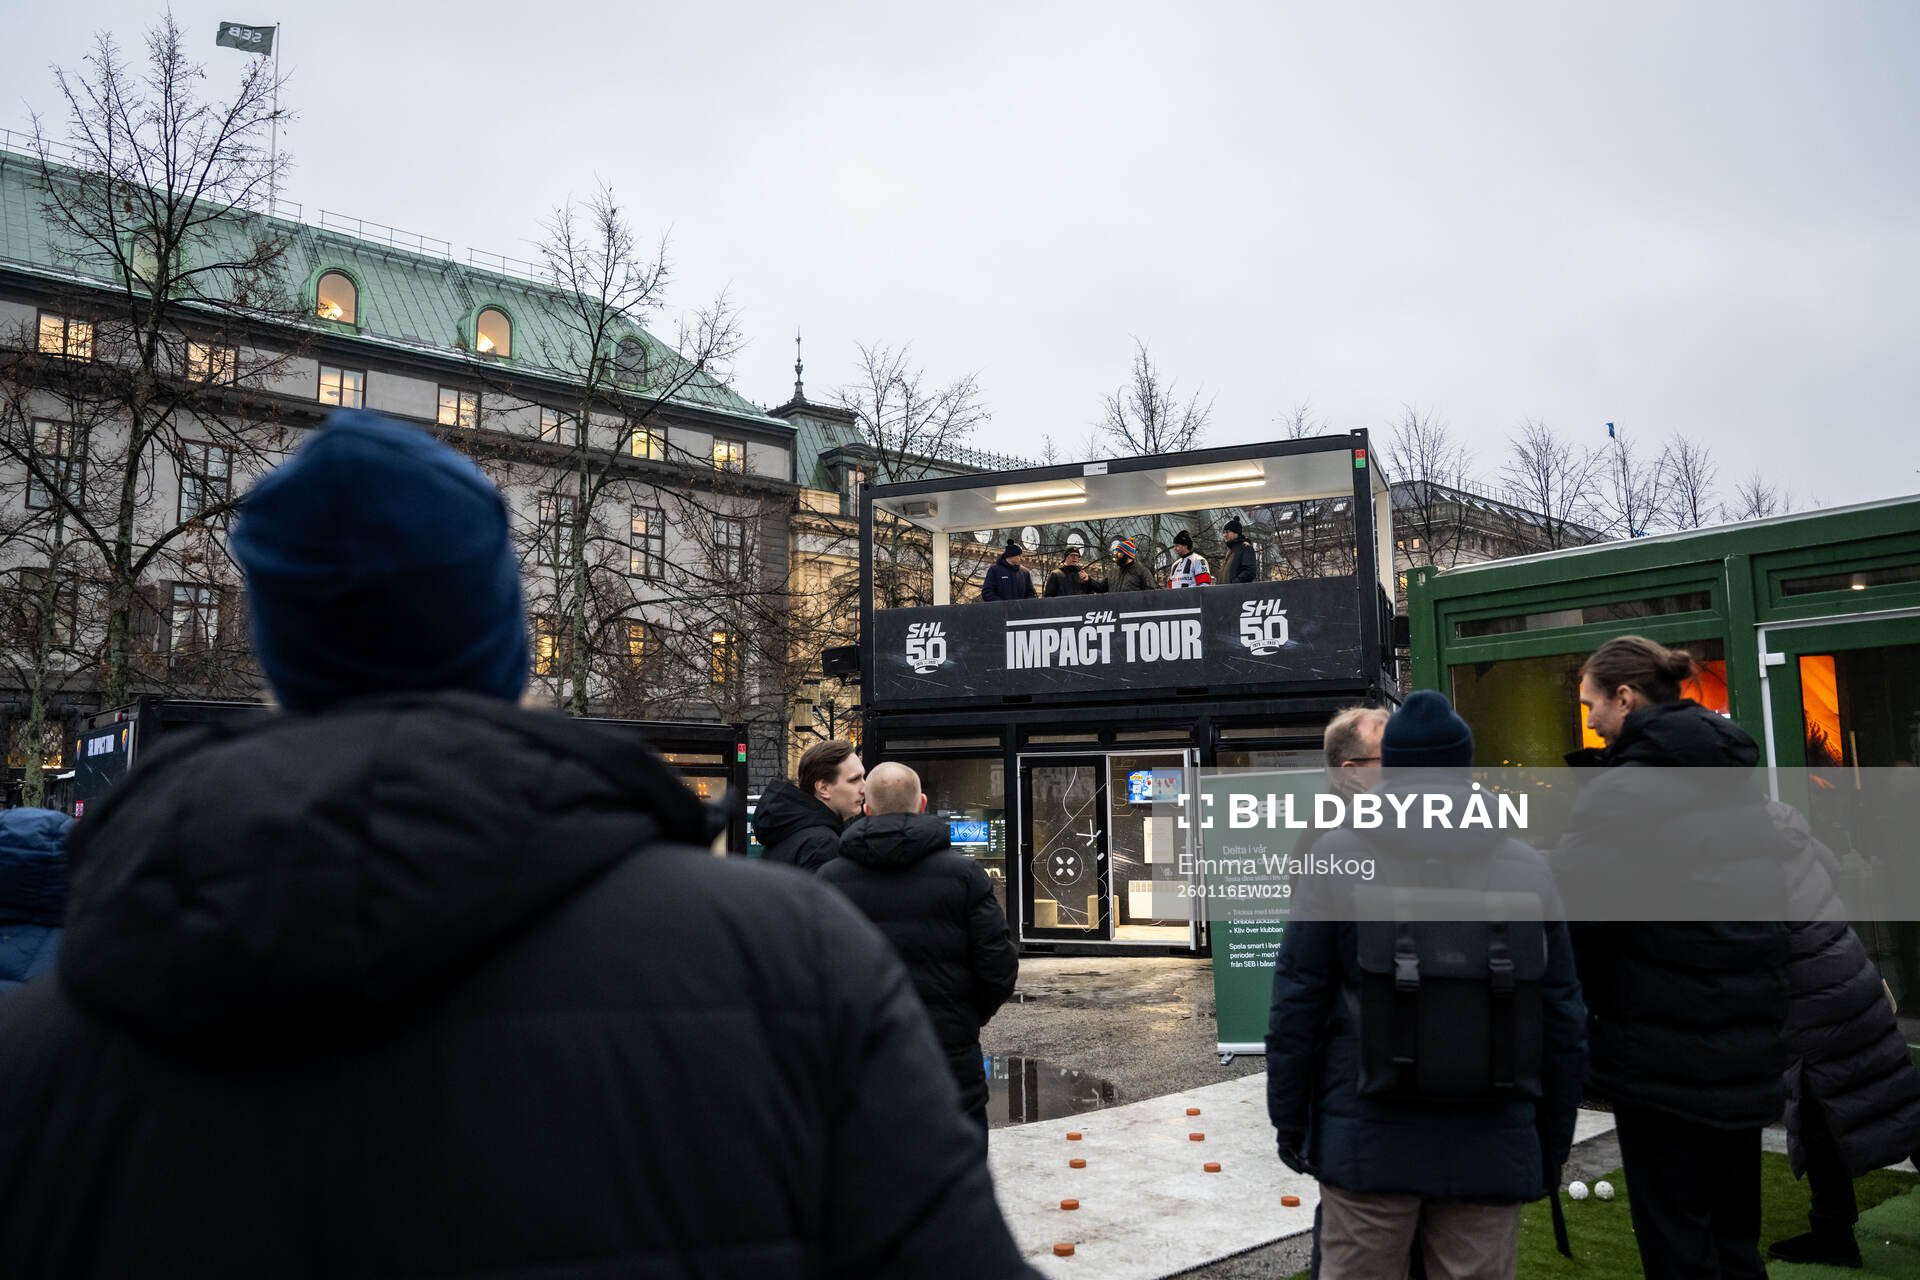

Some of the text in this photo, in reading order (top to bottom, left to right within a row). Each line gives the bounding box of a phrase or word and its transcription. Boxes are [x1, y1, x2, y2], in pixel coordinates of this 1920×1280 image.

[1240, 599, 1287, 617] SHL
[1084, 610, 1117, 624] SHL
[906, 621, 946, 638] SHL
[1240, 615, 1288, 647] 50
[906, 637, 947, 666] 50
[1006, 619, 1203, 670] IMPACT TOUR
[1222, 845, 1247, 855] Delta
[1252, 844, 1267, 854] vår
[1230, 951, 1255, 960] perioder
